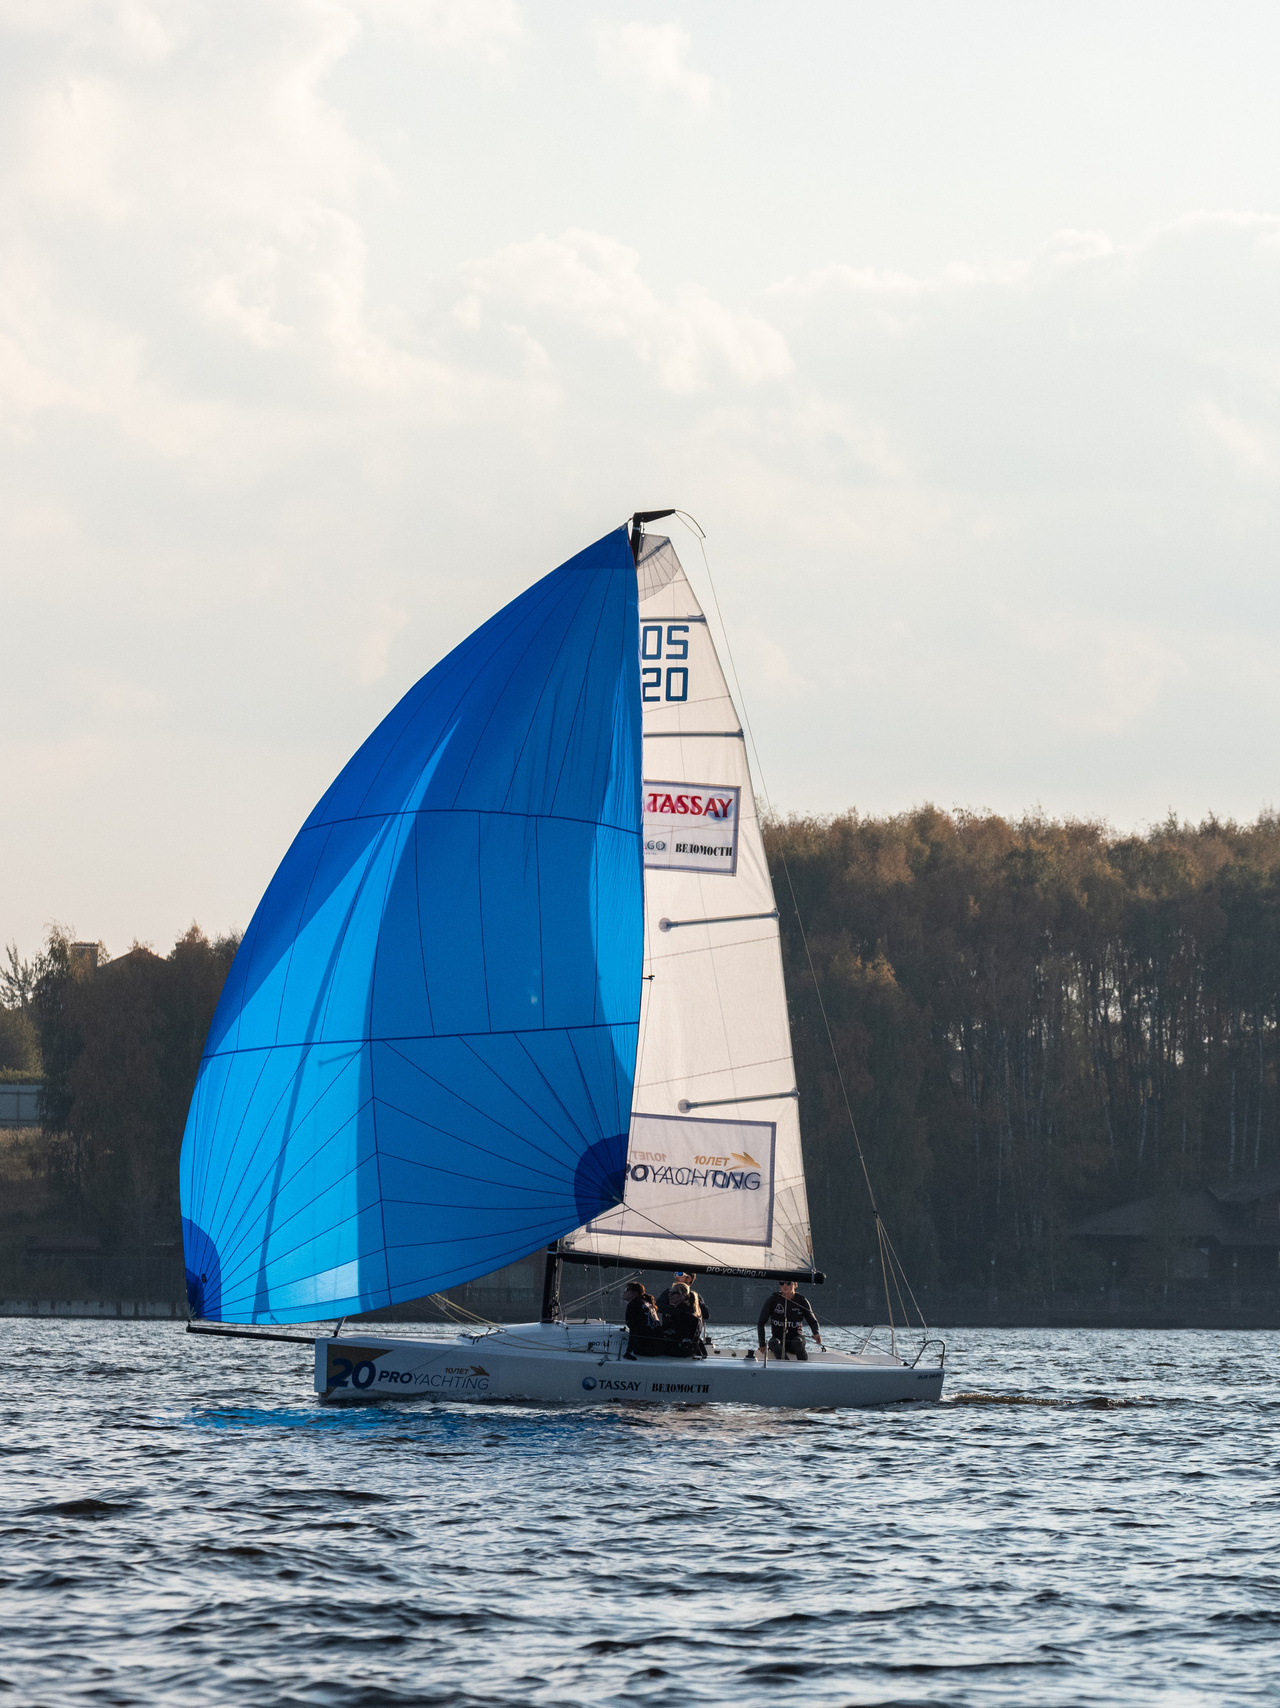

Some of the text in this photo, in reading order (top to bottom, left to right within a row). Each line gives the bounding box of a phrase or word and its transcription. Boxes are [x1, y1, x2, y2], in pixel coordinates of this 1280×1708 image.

[642, 667, 689, 702] 20
[648, 793, 733, 818] TASSAY
[675, 843, 733, 857] ВЕДОМОСТИ
[706, 1266, 767, 1278] pro-yachting.ru
[327, 1358, 376, 1389] 20
[377, 1370, 490, 1391] PROYACHTING
[598, 1380, 642, 1391] TASSAY
[651, 1383, 710, 1393] ВЕДОМОСТИ
